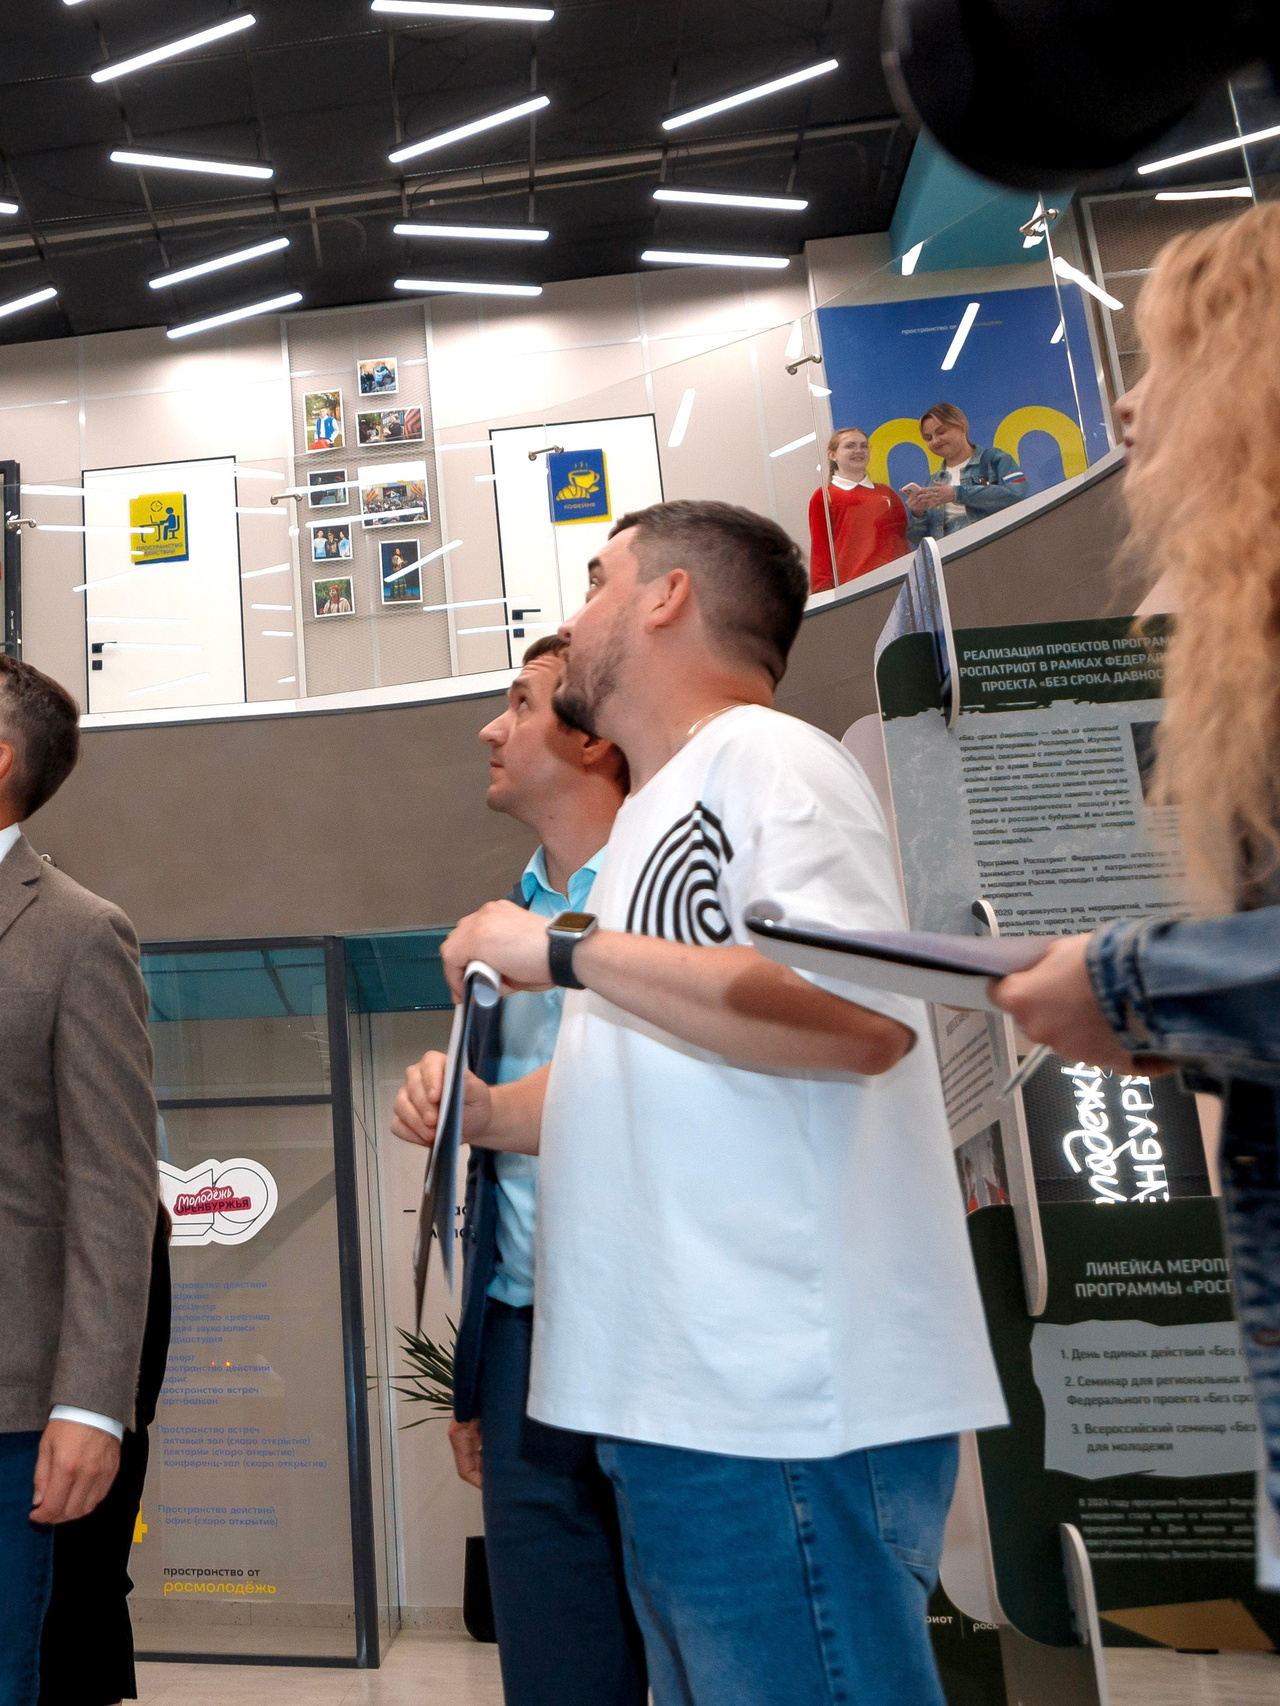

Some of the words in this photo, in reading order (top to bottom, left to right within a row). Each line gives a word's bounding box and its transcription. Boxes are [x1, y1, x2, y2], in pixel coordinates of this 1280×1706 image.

[964, 646, 1044, 661] РЕАЛИЗАЦИЯ
[1046, 641, 1110, 654] ПРОЕКТОВ
[960, 662, 1036, 677] РОСПАТРИОТ
[1040, 661, 1048, 672] В
[1051, 657, 1103, 670] РАМКАХ
[982, 679, 1037, 692] ПРОЕКТА
[1040, 676, 1068, 688] «БЕЗ
[1070, 673, 1112, 686] СРОКА
[1086, 1258, 1164, 1277] ЛИНЕЙКА
[1075, 1281, 1182, 1298] ПРОГРАММЫ
[1060, 1350, 1069, 1360] 1.
[1072, 1349, 1100, 1361] День
[1103, 1350, 1147, 1361] единых
[1151, 1346, 1206, 1359] действий
[1065, 1376, 1075, 1387] 2.
[1078, 1376, 1128, 1389] Семинар
[1131, 1376, 1153, 1387] для
[1156, 1376, 1241, 1388] региональных
[1067, 1394, 1150, 1408] Федерального
[1153, 1396, 1201, 1406] проекта
[1203, 1392, 1230, 1403] «Без
[156, 1424, 224, 1435] Пространство
[1072, 1424, 1082, 1435] 3.
[1085, 1422, 1174, 1436] Всероссийский
[1176, 1425, 1226, 1435] семинар
[1230, 1421, 1256, 1432] «Без
[1087, 1443, 1110, 1454] для
[1112, 1442, 1174, 1453] молодежи
[158, 1504, 227, 1515] Пространство
[194, 1516, 226, 1527] (скоро
[163, 1567, 244, 1578] пространство
[247, 1568, 260, 1577] от
[164, 1581, 276, 1597] росмолодёжь
